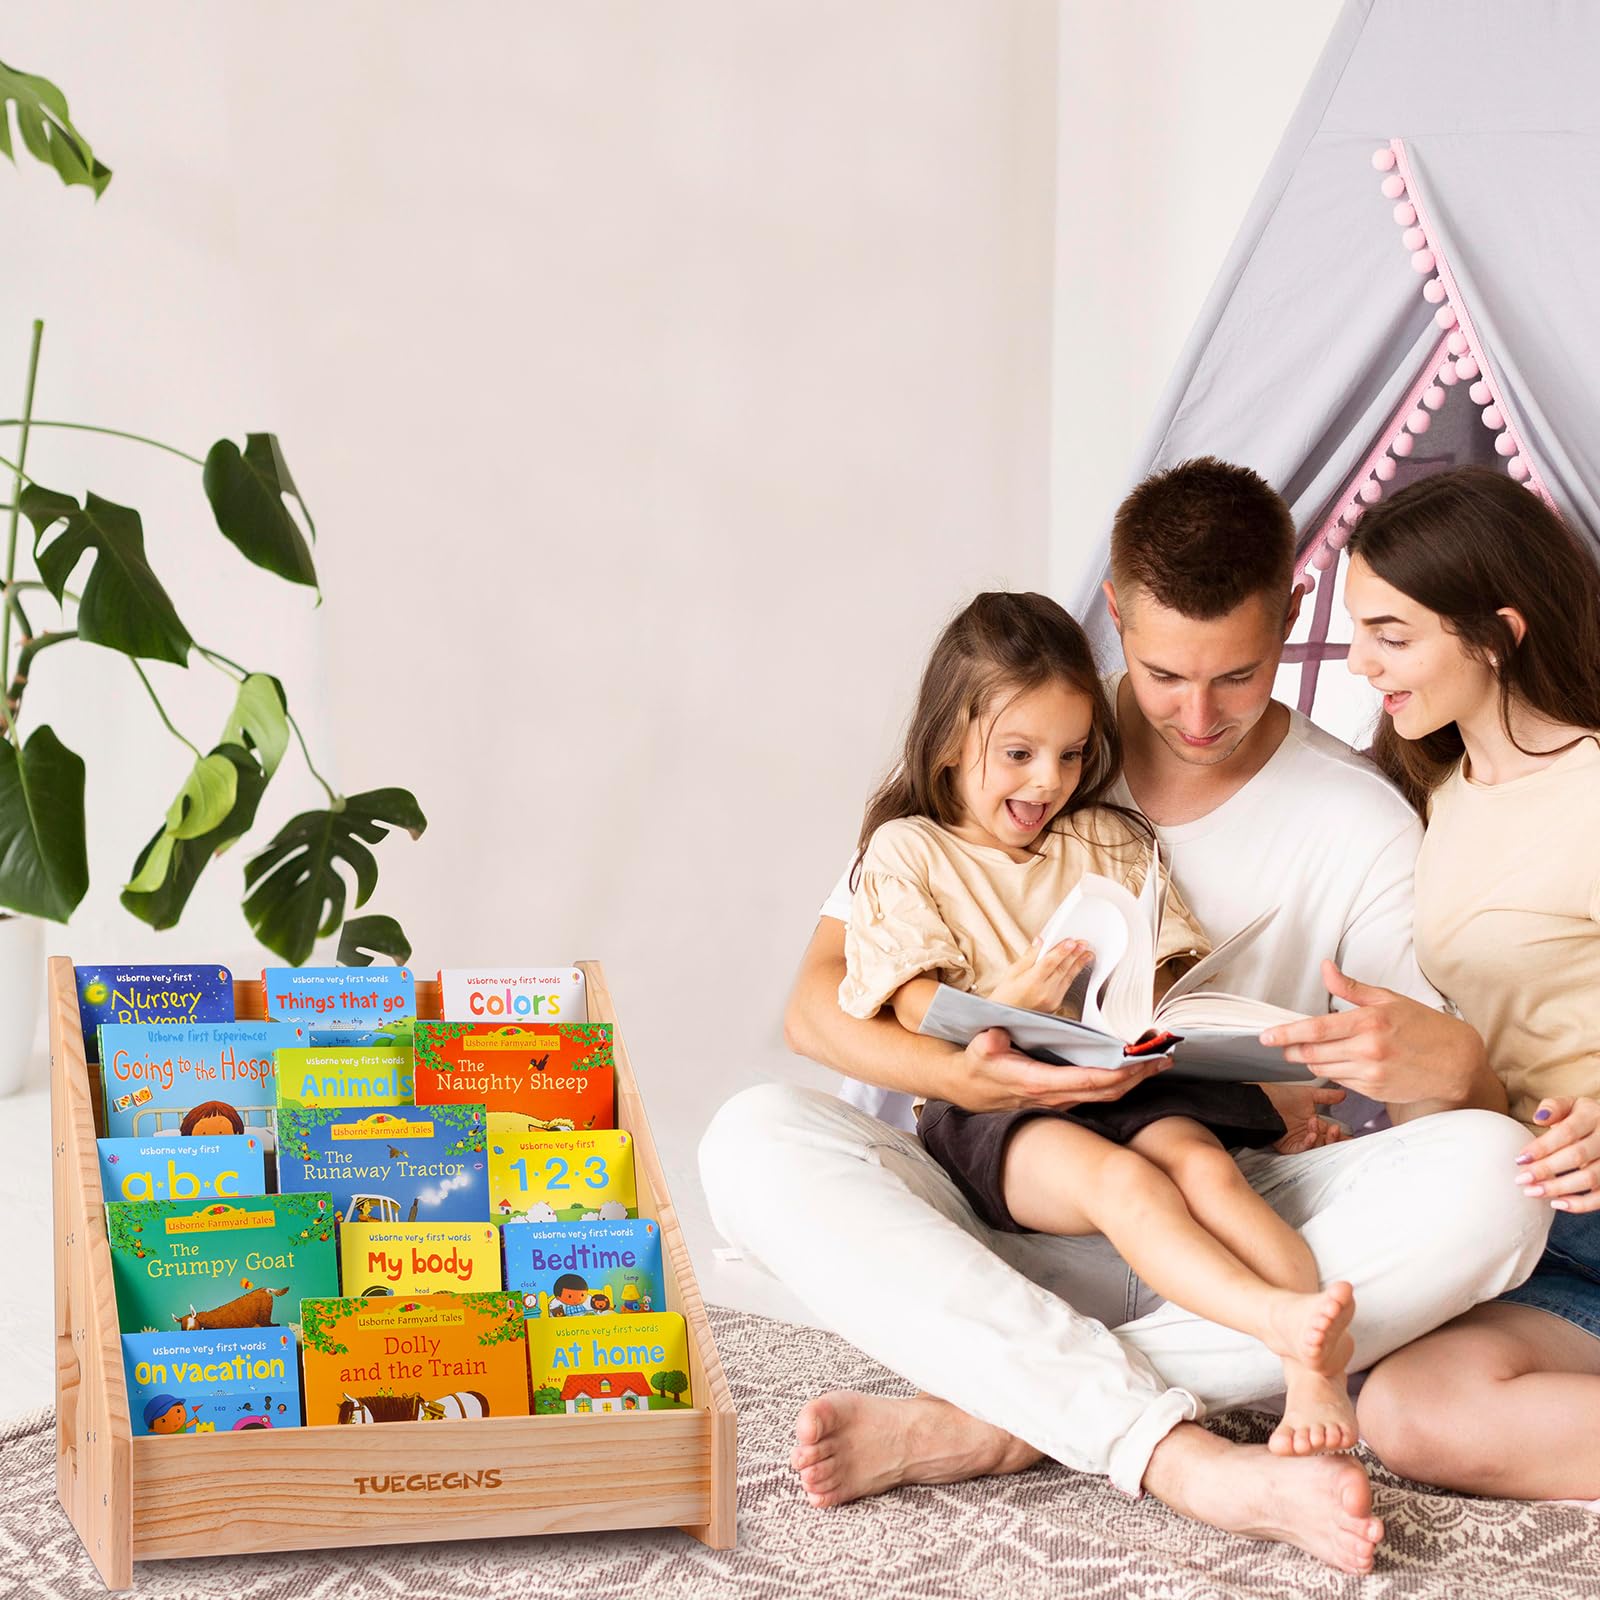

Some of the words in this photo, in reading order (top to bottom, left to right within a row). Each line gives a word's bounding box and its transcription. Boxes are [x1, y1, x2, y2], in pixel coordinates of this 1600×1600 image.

[152, 975, 171, 983] very
[173, 973, 192, 982] first
[326, 976, 344, 984] very
[500, 978, 517, 986] very
[519, 976, 536, 984] first
[539, 976, 560, 984] words
[112, 987, 202, 1014] Nursery
[276, 992, 335, 1013] Things
[340, 992, 378, 1008] that
[383, 995, 404, 1012] go
[148, 1031, 184, 1042] Usborne
[188, 1030, 209, 1041] First
[213, 1028, 267, 1044] Experiences
[465, 1039, 498, 1047] Usborne
[501, 1039, 537, 1048] Farmyard
[540, 1039, 558, 1047] Tales
[341, 1058, 358, 1066] very
[458, 1060, 484, 1072] The
[113, 1050, 173, 1090] Going
[177, 1056, 191, 1073] to
[194, 1060, 217, 1081] the
[300, 1068, 413, 1097] Animals
[437, 1073, 523, 1093] Naughty
[530, 1073, 588, 1094] Sheep
[334, 1127, 368, 1136] Usborne
[370, 1127, 409, 1136] Farmyard
[412, 1126, 432, 1134] Tales
[178, 1147, 198, 1156] very
[200, 1145, 220, 1153] first
[555, 1143, 574, 1151] very
[576, 1140, 595, 1148] first
[325, 1151, 353, 1164] The
[304, 1164, 391, 1181] Runaway
[396, 1161, 464, 1177] Tractor
[168, 1221, 205, 1231] Usborne
[208, 1218, 248, 1229] Farmyard
[252, 1216, 273, 1225] Tales
[406, 1235, 424, 1243] very
[426, 1233, 445, 1241] first
[568, 1231, 587, 1239] very
[589, 1228, 607, 1237] first
[610, 1228, 634, 1236] words
[170, 1244, 199, 1257] The
[532, 1244, 636, 1270] Bedtime
[147, 1259, 238, 1279] Grumpy
[246, 1252, 295, 1270] Goat
[368, 1252, 403, 1281] My
[412, 1247, 473, 1281] body
[359, 1318, 395, 1326] Usborne
[398, 1316, 438, 1326] Farmyard
[442, 1314, 462, 1322] Tales
[192, 1346, 213, 1354] very
[216, 1343, 237, 1351] first
[240, 1342, 266, 1350] words
[384, 1336, 441, 1357] Dolly
[552, 1342, 582, 1368] At
[592, 1340, 665, 1366] home
[135, 1362, 167, 1385] On
[172, 1354, 284, 1383] vacation
[340, 1363, 382, 1382] and
[388, 1362, 422, 1379] the
[428, 1359, 487, 1377] Train
[354, 1469, 503, 1494] TUEGEGNS
